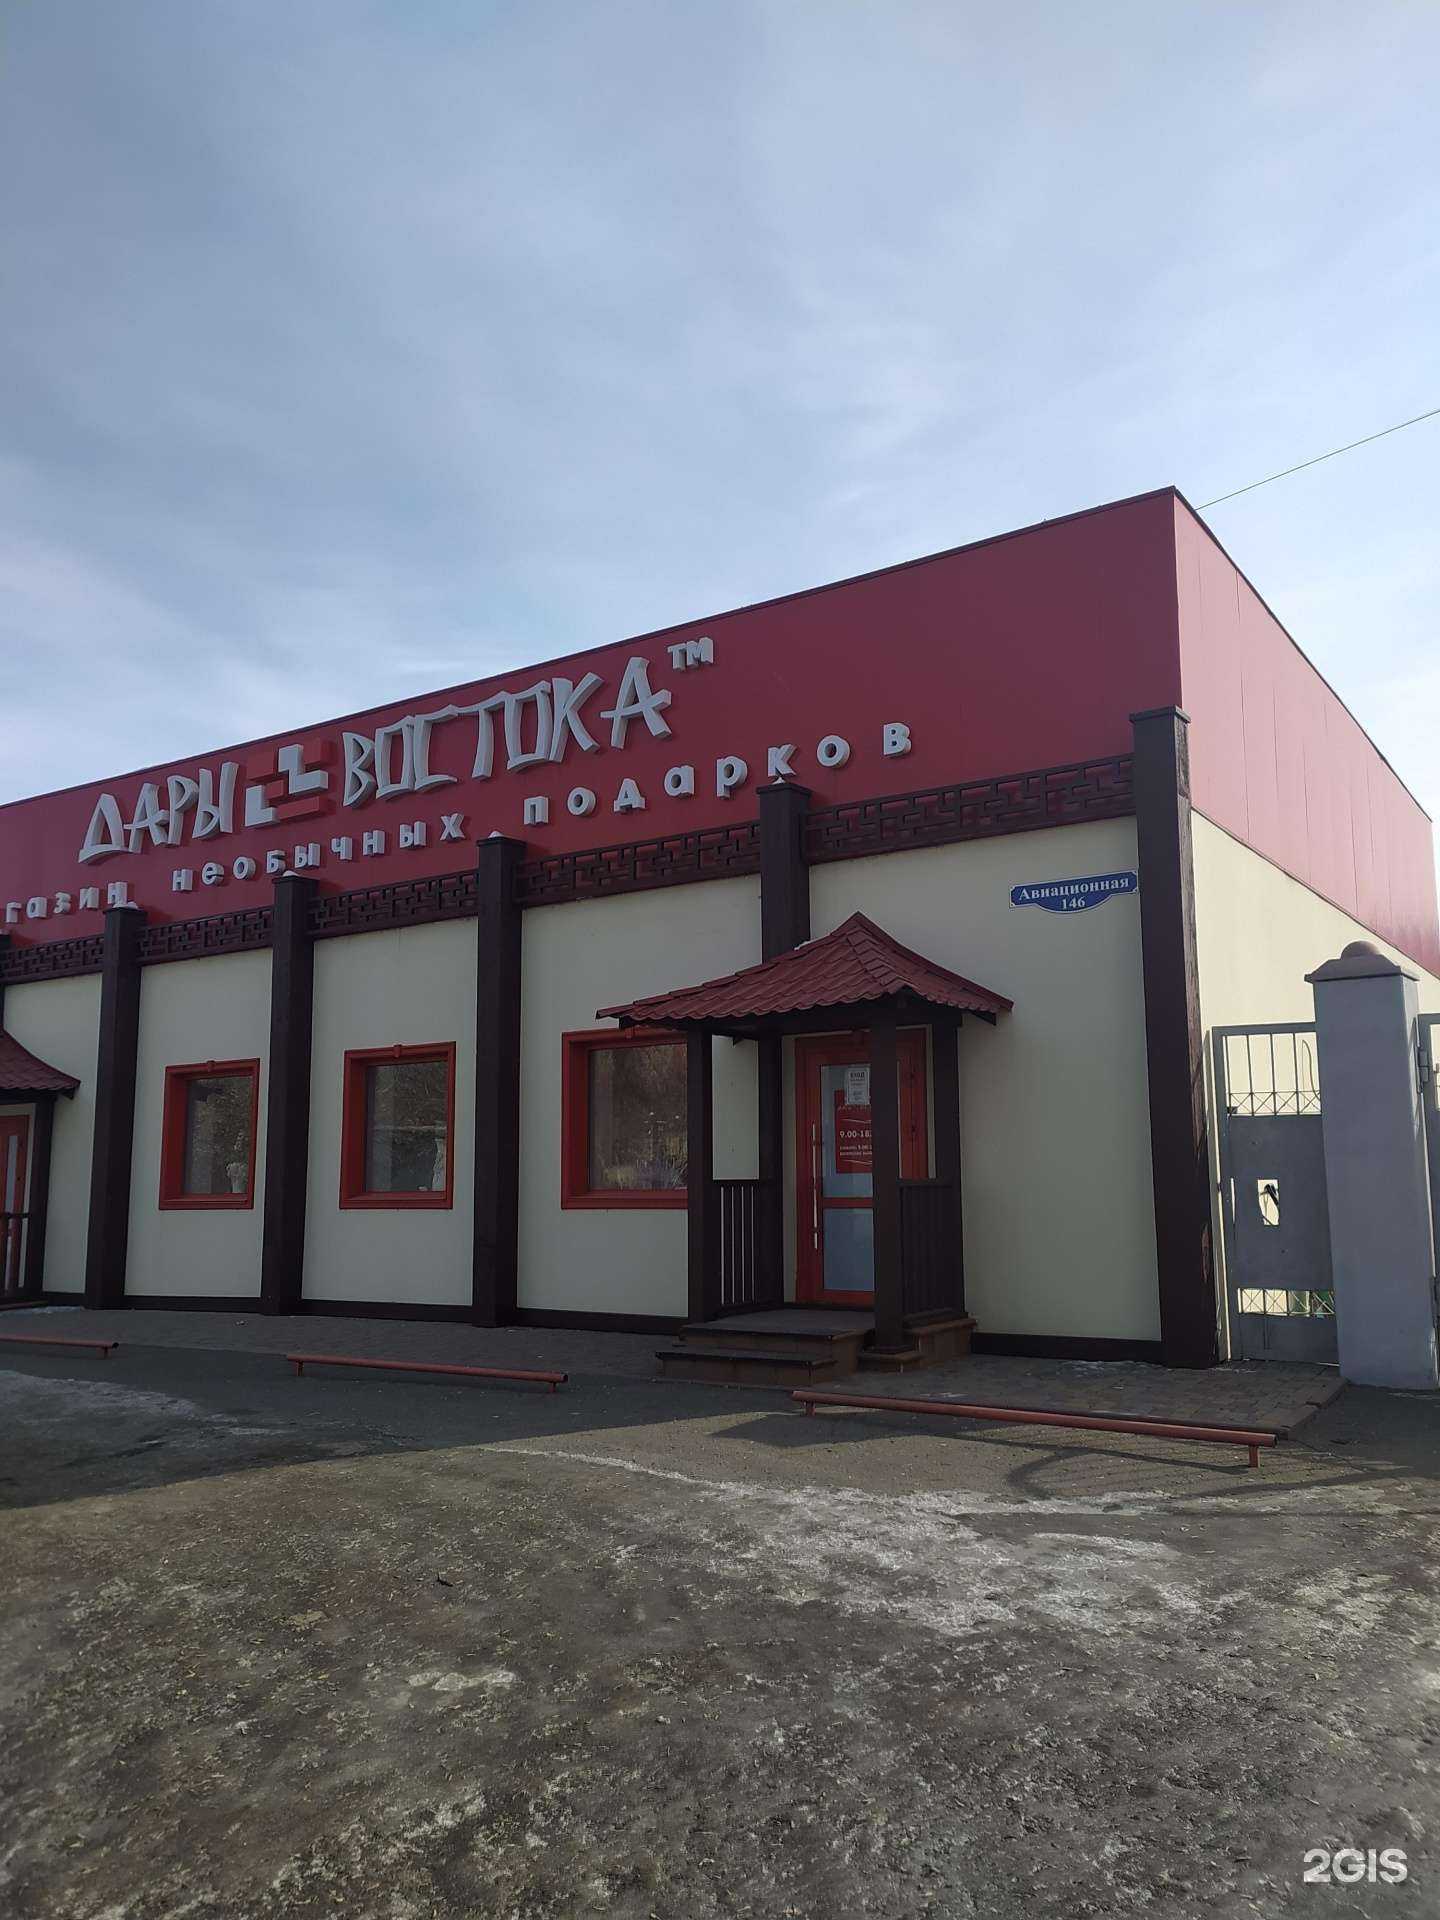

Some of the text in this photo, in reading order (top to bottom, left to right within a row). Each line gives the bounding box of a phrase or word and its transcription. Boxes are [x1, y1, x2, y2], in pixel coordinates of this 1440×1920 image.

[78, 761, 240, 864] ДАРЫ
[342, 656, 673, 807] ВОСТОКА
[172, 812, 466, 892] необычных
[523, 722, 912, 826] подарков
[1019, 877, 1129, 901] Авиационная
[1061, 895, 1086, 911] 146
